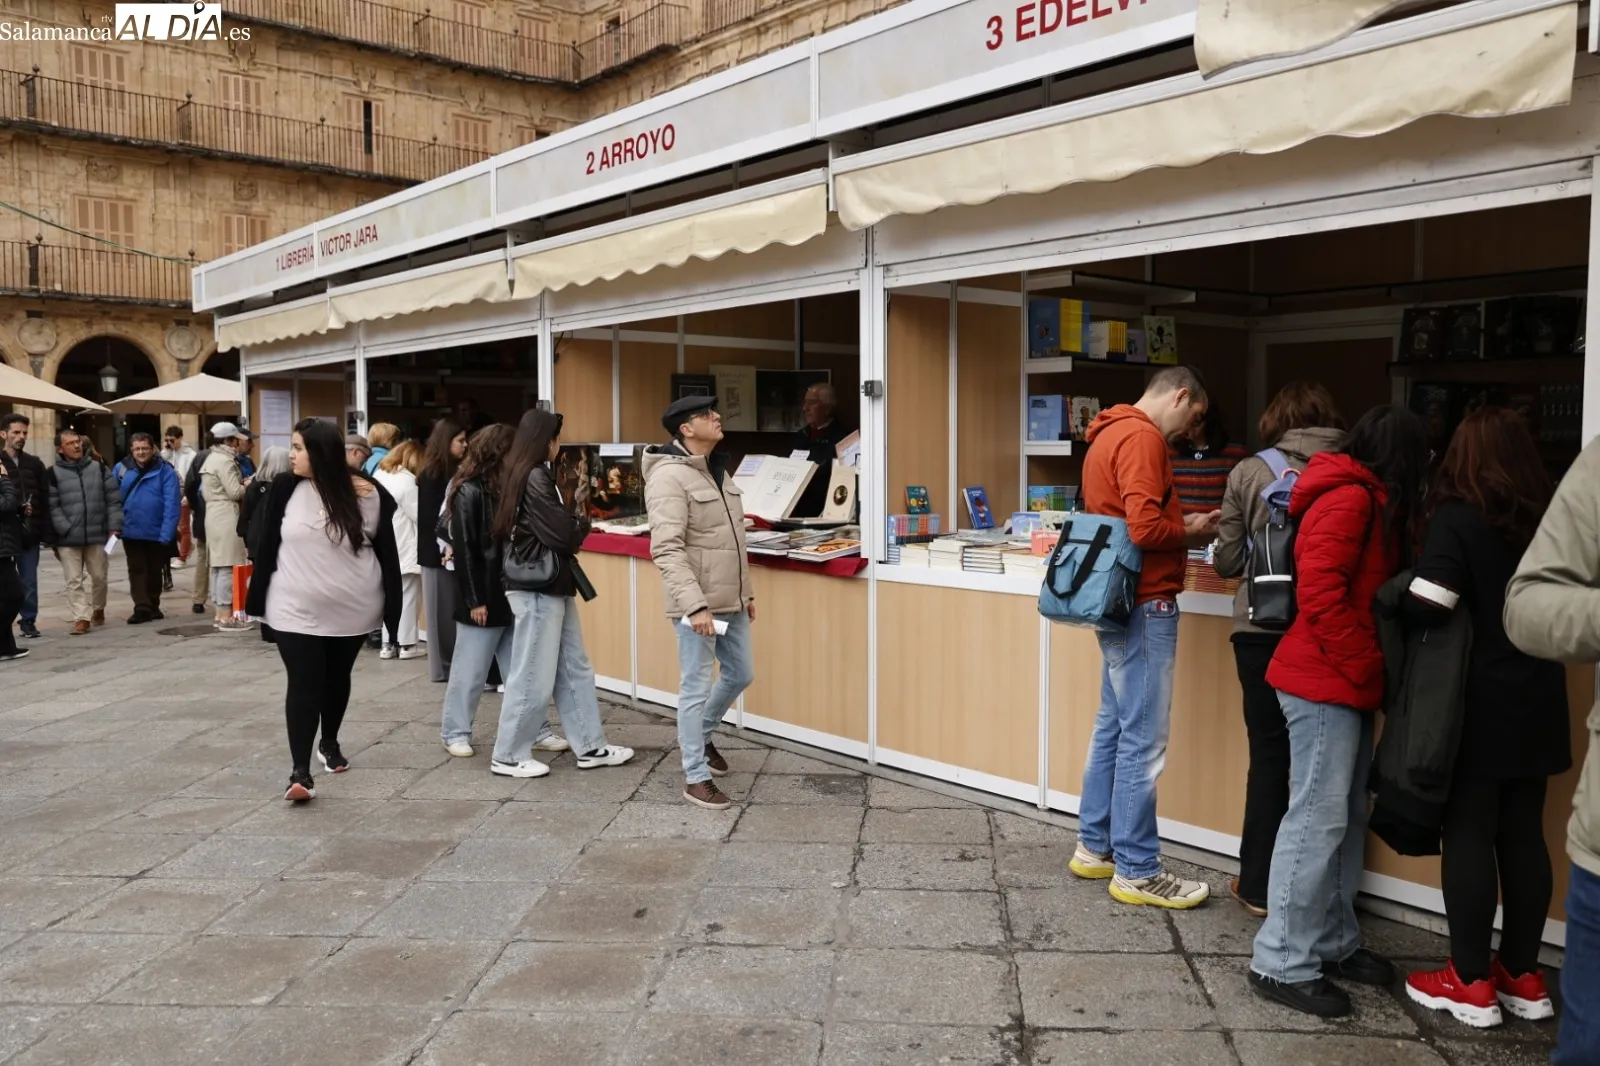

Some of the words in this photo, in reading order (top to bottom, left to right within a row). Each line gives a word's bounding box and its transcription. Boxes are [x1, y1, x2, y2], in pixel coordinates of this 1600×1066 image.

[986, 15, 1003, 50] 3
[586, 151, 595, 175] 2
[599, 123, 675, 171] ARROYO
[276, 256, 280, 271] 1
[320, 232, 352, 257] VICTOR
[354, 224, 379, 248] JARA
